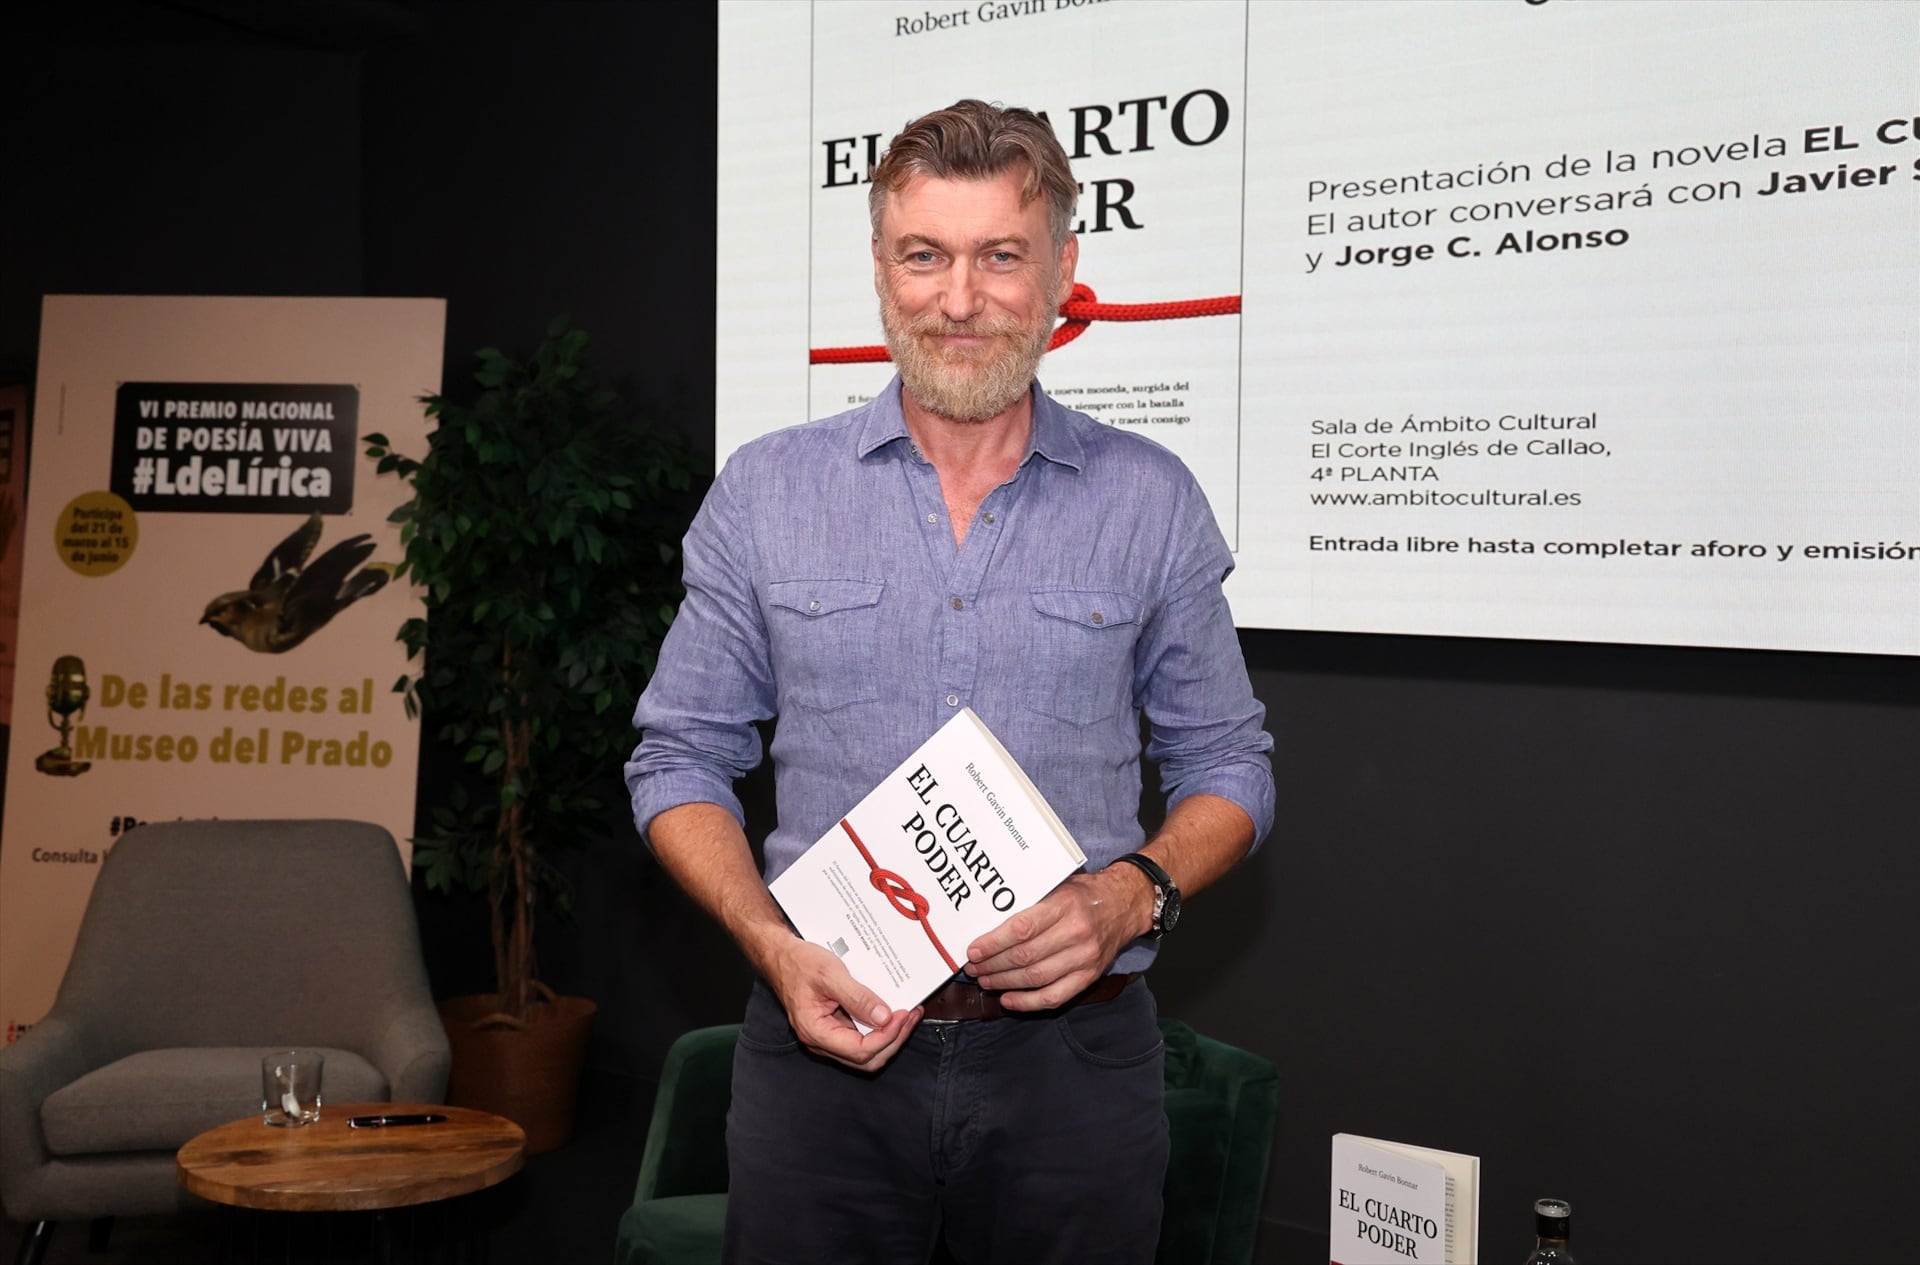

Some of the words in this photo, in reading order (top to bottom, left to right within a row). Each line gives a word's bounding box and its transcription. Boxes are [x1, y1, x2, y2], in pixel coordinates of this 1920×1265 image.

[896, 9, 971, 37] Robert
[977, 0, 1045, 22] Gavin
[1037, 89, 1230, 160] RTO
[1308, 161, 1531, 204] Presentación
[1545, 154, 1591, 179] de
[1606, 150, 1636, 174] la
[1652, 134, 1786, 169] novela
[1804, 125, 1860, 154] EL
[1308, 212, 1334, 236] El
[1347, 208, 1437, 232] autor
[1449, 183, 1653, 224] conversará
[1668, 180, 1741, 204] con
[1757, 163, 1897, 196] Javier
[1305, 252, 1323, 274] y
[1335, 244, 1435, 267] Jorge
[1447, 236, 1481, 258] C.
[1495, 229, 1629, 255] Alonso
[1172, 382, 1190, 392] del
[139, 400, 159, 418] VI
[164, 400, 238, 419] PREMIO
[241, 401, 335, 421] NACIONAL
[1136, 399, 1148, 409] la
[136, 427, 168, 451] DE
[176, 421, 264, 452] POESÍA
[273, 428, 332, 453] VIVA
[1311, 419, 1357, 435] Sala
[1364, 417, 1393, 434] de
[1400, 414, 1491, 433] Ámbito
[1498, 412, 1597, 431] Cultural
[1311, 442, 1330, 459] El
[1338, 442, 1402, 458] Corte
[1409, 440, 1479, 460] Inglés
[1487, 439, 1519, 456] de
[1526, 438, 1611, 457] Callao,
[133, 455, 332, 498] #LdeLírica
[1310, 467, 1333, 482] 4ª
[1341, 466, 1439, 482] PLANTA
[1310, 489, 1582, 506] www.ambitocultural.es
[71, 522, 88, 534] del
[92, 522, 106, 534] 21
[109, 522, 123, 534] de
[73, 507, 122, 522] Participa
[71, 550, 85, 563] de
[1309, 535, 1399, 552] Entrada
[1407, 536, 1459, 553] libre
[1468, 537, 1535, 554] hasta
[1543, 539, 1682, 559] completar
[1690, 540, 1767, 558] aforo
[1777, 545, 1794, 562] y
[1803, 541, 1920, 560] emisión
[101, 674, 149, 711] De
[158, 673, 213, 711] las
[222, 676, 328, 714] redes
[337, 678, 374, 714] al
[73, 726, 200, 764] Museo
[208, 727, 270, 764] del
[279, 730, 393, 768] Prado
[965, 762, 990, 795] Robert
[986, 790, 1007, 821] Gavin
[1003, 816, 1031, 852] Bonnar
[906, 763, 939, 806] EL
[935, 803, 1017, 913] CUARTO
[32, 848, 98, 864] Consulta
[901, 810, 973, 911] PODER
[1358, 1163, 1378, 1177] Robert
[1378, 1169, 1396, 1183] Gavin
[1396, 1175, 1418, 1191] Bonnar
[1338, 1188, 1360, 1213] EL
[1365, 1198, 1438, 1239] CUARTO
[1357, 1219, 1418, 1260] PODER
